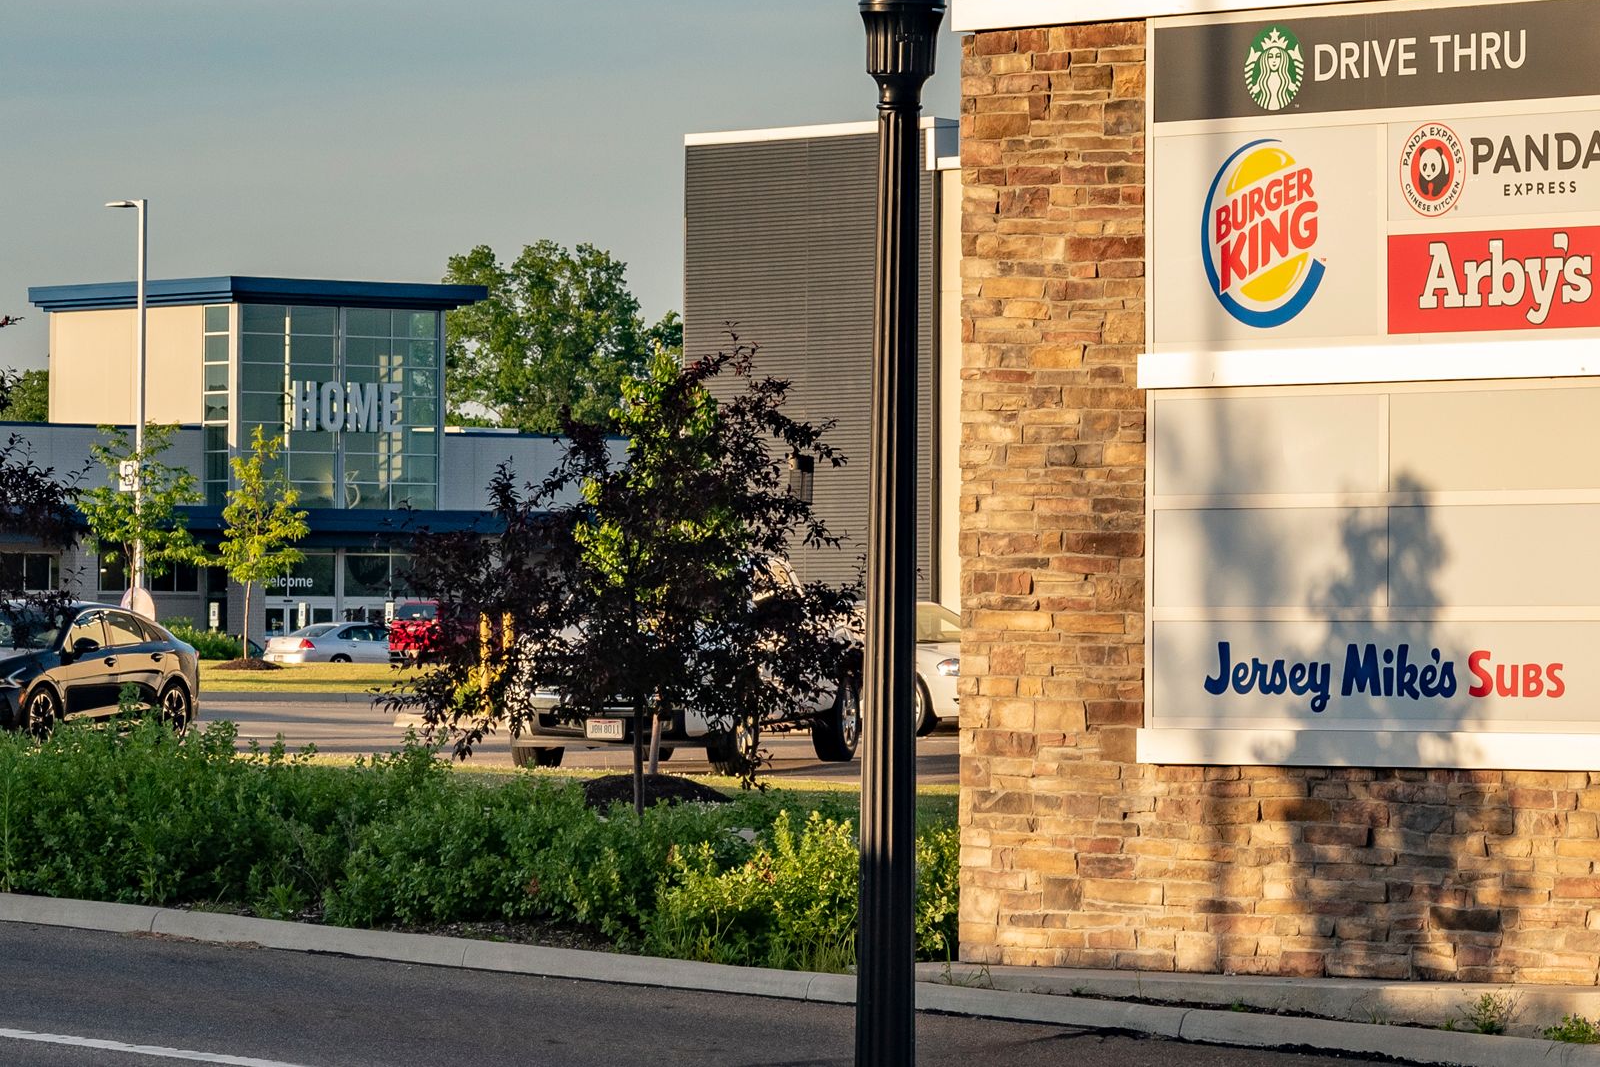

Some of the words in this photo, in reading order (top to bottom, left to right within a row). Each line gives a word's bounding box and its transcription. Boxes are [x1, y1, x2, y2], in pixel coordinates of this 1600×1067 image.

[1313, 37, 1418, 82] DRIVE
[1429, 29, 1527, 74] THRU
[1403, 130, 1428, 166] PANDA
[1429, 126, 1463, 164] EXPRESS
[1215, 167, 1315, 245] BURGER
[1405, 183, 1431, 212] CHINESE
[1433, 181, 1461, 212] KITCHEN
[1503, 180, 1577, 196] EXPRESS
[1220, 200, 1319, 293] KING
[1418, 231, 1593, 325] Arby's
[293, 380, 402, 432] HOME
[1203, 641, 1331, 713] Jersey
[1341, 642, 1458, 701] Mike's
[1467, 649, 1566, 700] SUBS
